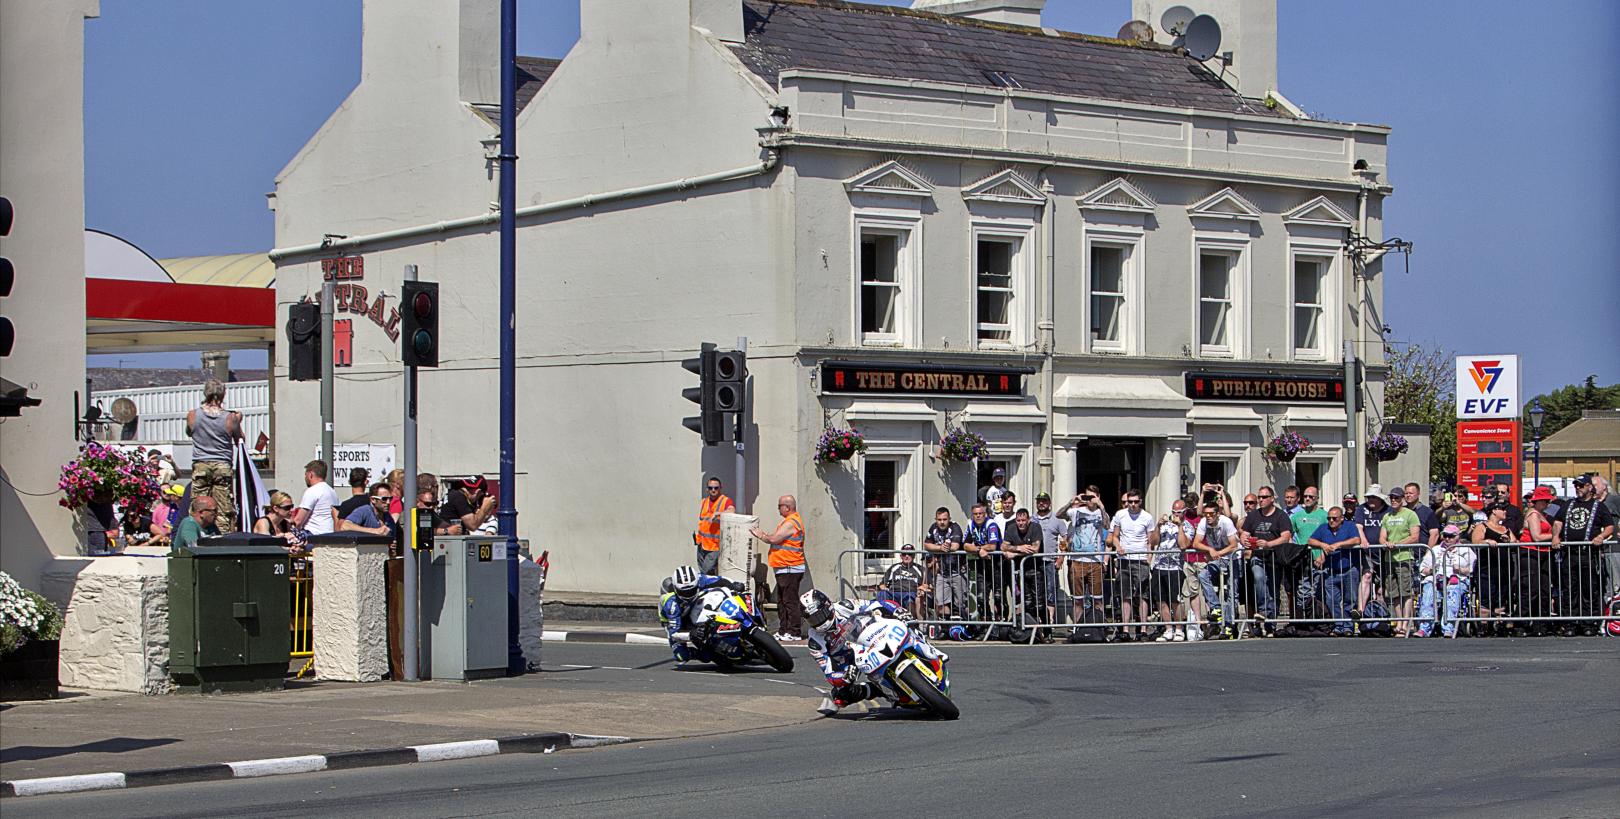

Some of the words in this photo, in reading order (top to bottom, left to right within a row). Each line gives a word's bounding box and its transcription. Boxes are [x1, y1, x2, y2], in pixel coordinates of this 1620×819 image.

[321, 256, 364, 281] THE
[856, 371, 896, 389] THE
[901, 372, 989, 391] CENTRAL
[1212, 380, 1271, 396] PUBLIC
[1274, 382, 1327, 398] HOUSE
[1463, 398, 1509, 414] EVF
[338, 451, 370, 462] SPORTS
[480, 546, 490, 559] 60
[273, 563, 285, 575] 20
[720, 599, 738, 616] 8
[888, 625, 906, 642] 10
[867, 651, 881, 668] 10
